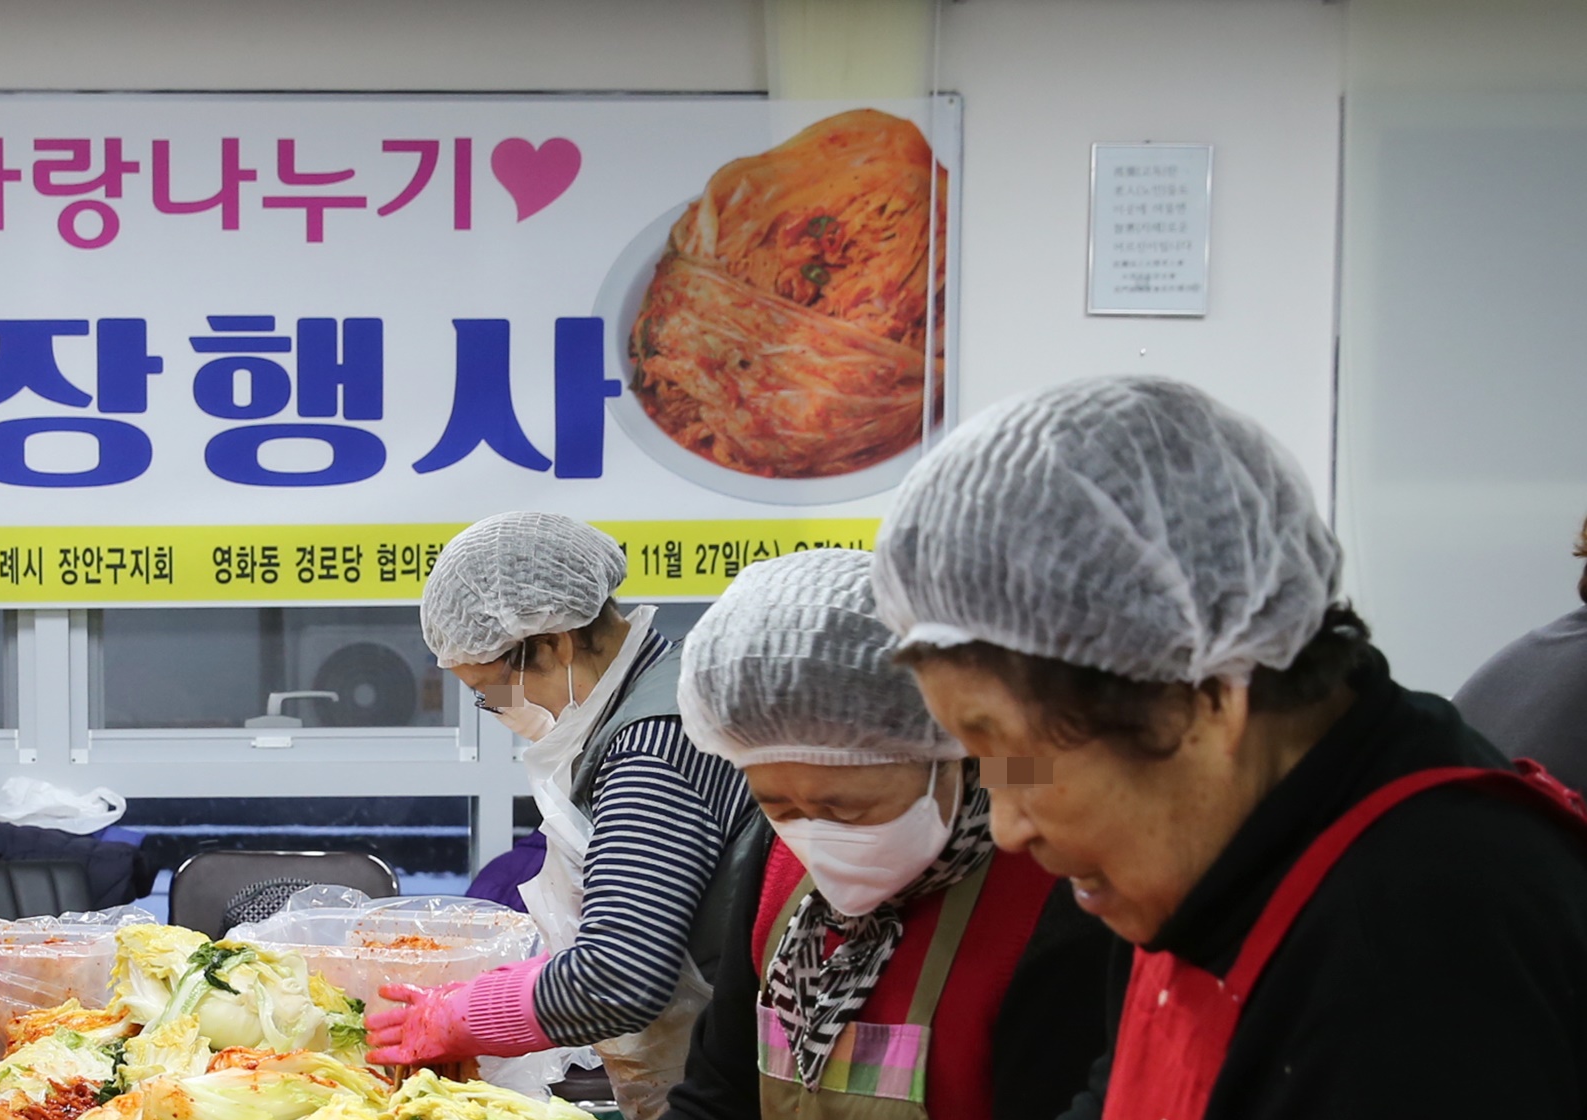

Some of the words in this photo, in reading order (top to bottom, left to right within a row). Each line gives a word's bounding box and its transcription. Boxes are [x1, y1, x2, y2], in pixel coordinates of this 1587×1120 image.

[58, 546, 173, 586] 장안구지회
[212, 545, 281, 585] 영화동
[295, 544, 363, 584] 경로당
[641, 540, 682, 579] 11월
